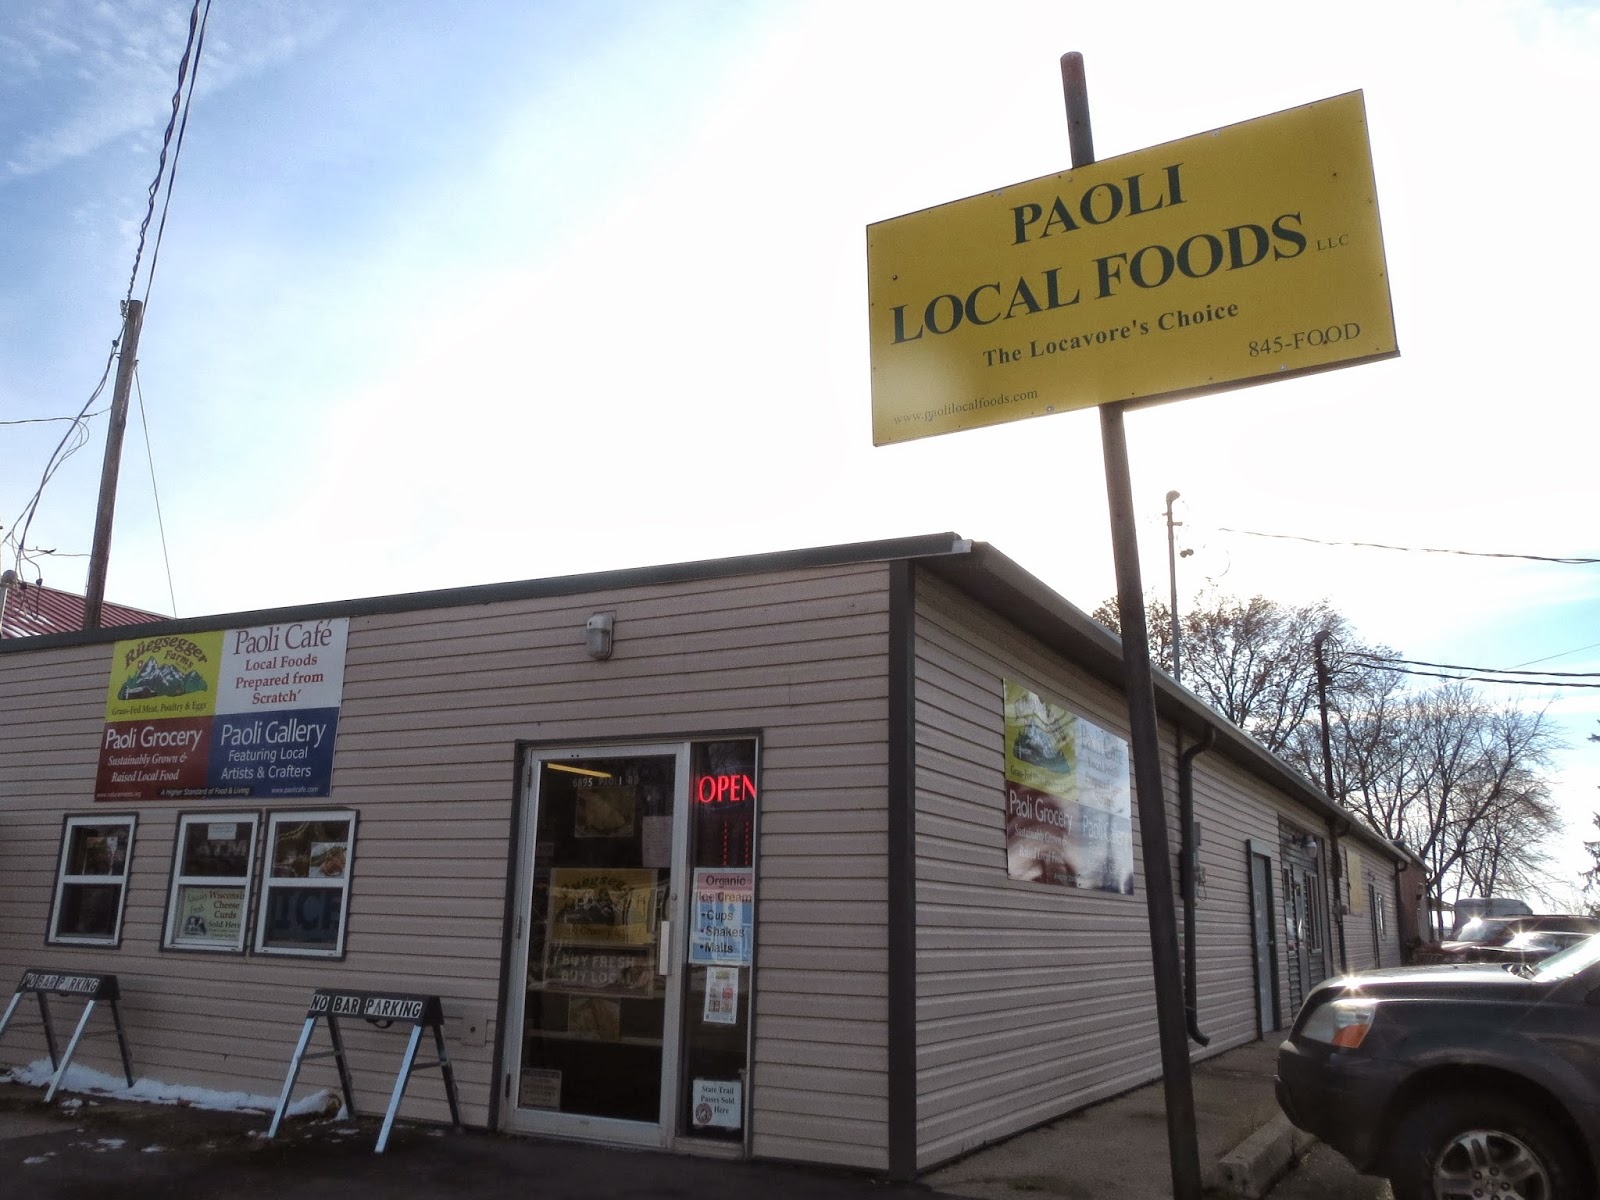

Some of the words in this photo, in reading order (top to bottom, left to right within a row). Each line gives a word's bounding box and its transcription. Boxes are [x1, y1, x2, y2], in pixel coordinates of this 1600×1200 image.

[1010, 163, 1188, 246] PAOLI
[889, 267, 1081, 345] LOCAL
[1093, 212, 1308, 300] FOODS
[1315, 233, 1350, 252] LLC
[983, 346, 1022, 367] The
[1029, 318, 1150, 359] Locavore's
[1157, 302, 1240, 332] Choice
[1248, 322, 1362, 358] 845-FOOD
[893, 388, 1039, 426] www.paolilocalfoods.com
[232, 627, 280, 655] Paoli
[284, 620, 333, 652] Café
[164, 650, 195, 669] Farms
[245, 658, 277, 672] Local
[280, 654, 318, 668] Foods
[235, 674, 290, 691] Prepared
[291, 672, 324, 685] from
[112, 704, 142, 716] Grass-Fed
[161, 702, 184, 713] Poultry
[184, 702, 191, 711] &
[192, 701, 207, 712] Eggs
[105, 727, 138, 750] Paoli
[140, 726, 203, 751] Grocery
[220, 721, 263, 746] Paoli
[265, 718, 327, 748] Gallery
[108, 753, 151, 766] Sustainably
[151, 754, 178, 764] Grown
[179, 752, 188, 764] &
[228, 748, 276, 763] Featuring
[280, 746, 308, 760] Local
[111, 771, 137, 783] Raised
[137, 770, 159, 782] Local
[159, 769, 180, 781] Food
[220, 767, 255, 780] Artists
[256, 767, 265, 778] &
[267, 764, 312, 779] Crafters
[167, 788, 184, 797] Higher
[184, 787, 208, 795] Standard
[214, 787, 228, 795] Food
[233, 786, 250, 796] Living
[697, 774, 756, 803] OPEN
[1009, 789, 1033, 819] Paoli
[1035, 798, 1073, 836] Grocery
[705, 875, 747, 889] Organic
[213, 901, 240, 909] Cheese
[698, 891, 715, 902] Ice
[717, 891, 752, 902] Cream
[214, 910, 237, 919] Curds
[706, 910, 734, 922] Cups
[208, 920, 223, 928] Sold
[705, 926, 745, 938] Shakes
[704, 942, 734, 954] Malts
[36, 975, 57, 989] BAR
[57, 976, 99, 992] PRKING
[310, 995, 328, 1012] NO
[333, 997, 360, 1014] BAR
[366, 998, 422, 1018] PARKING
[701, 1086, 717, 1094] State
[718, 1087, 734, 1095] Trail
[714, 1106, 729, 1114] Here
